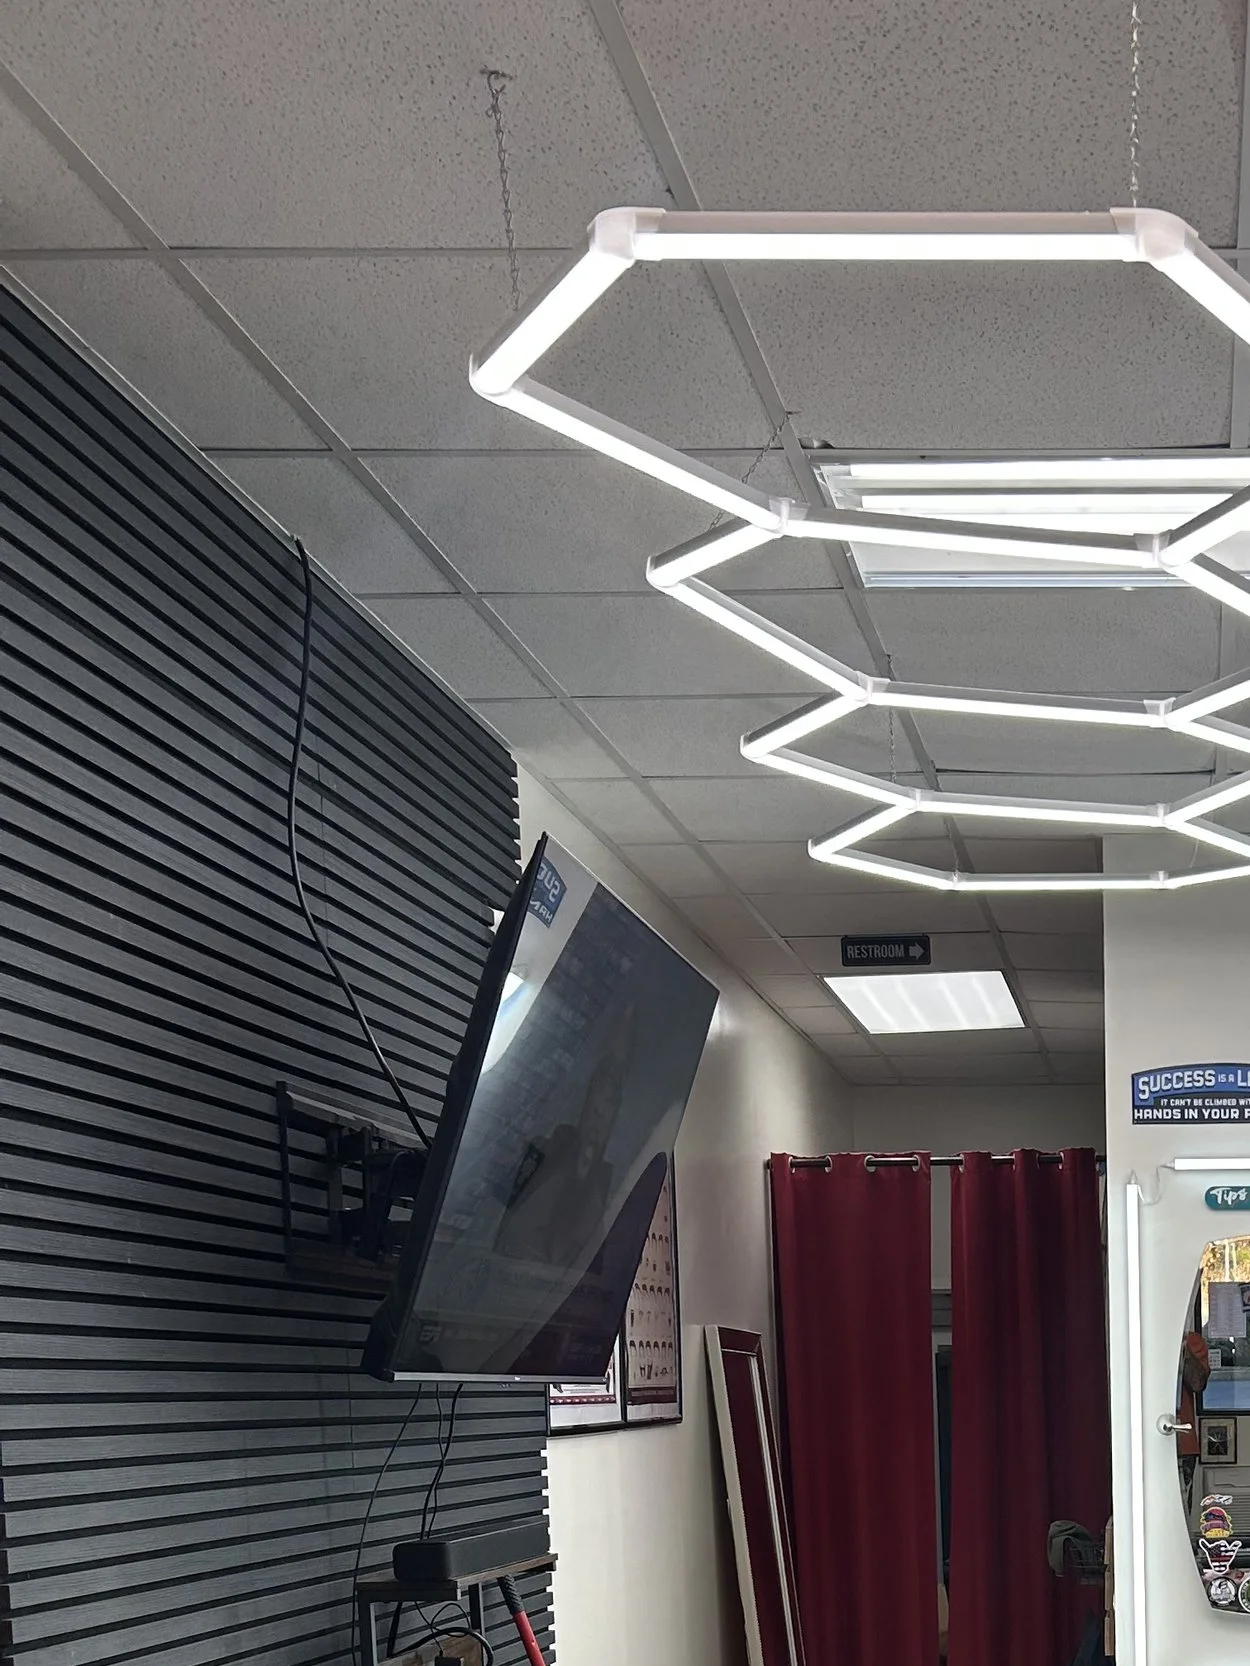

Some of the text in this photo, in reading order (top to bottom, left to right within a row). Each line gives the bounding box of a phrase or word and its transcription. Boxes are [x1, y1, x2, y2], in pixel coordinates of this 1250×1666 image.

[846, 943, 905, 959] RESTROOM
[1138, 1069, 1216, 1100] SUCCESS
[1218, 1074, 1227, 1083] IS
[1228, 1074, 1234, 1083] A
[1160, 1098, 1168, 1106] IT
[1170, 1098, 1191, 1106] CAN'T
[1193, 1098, 1203, 1106] BE
[1205, 1098, 1237, 1106] CLIMBED
[1134, 1108, 1181, 1120] HANDS
[1184, 1108, 1198, 1120] IN
[1202, 1108, 1240, 1120] YOUR
[1209, 1187, 1248, 1206] Tips
